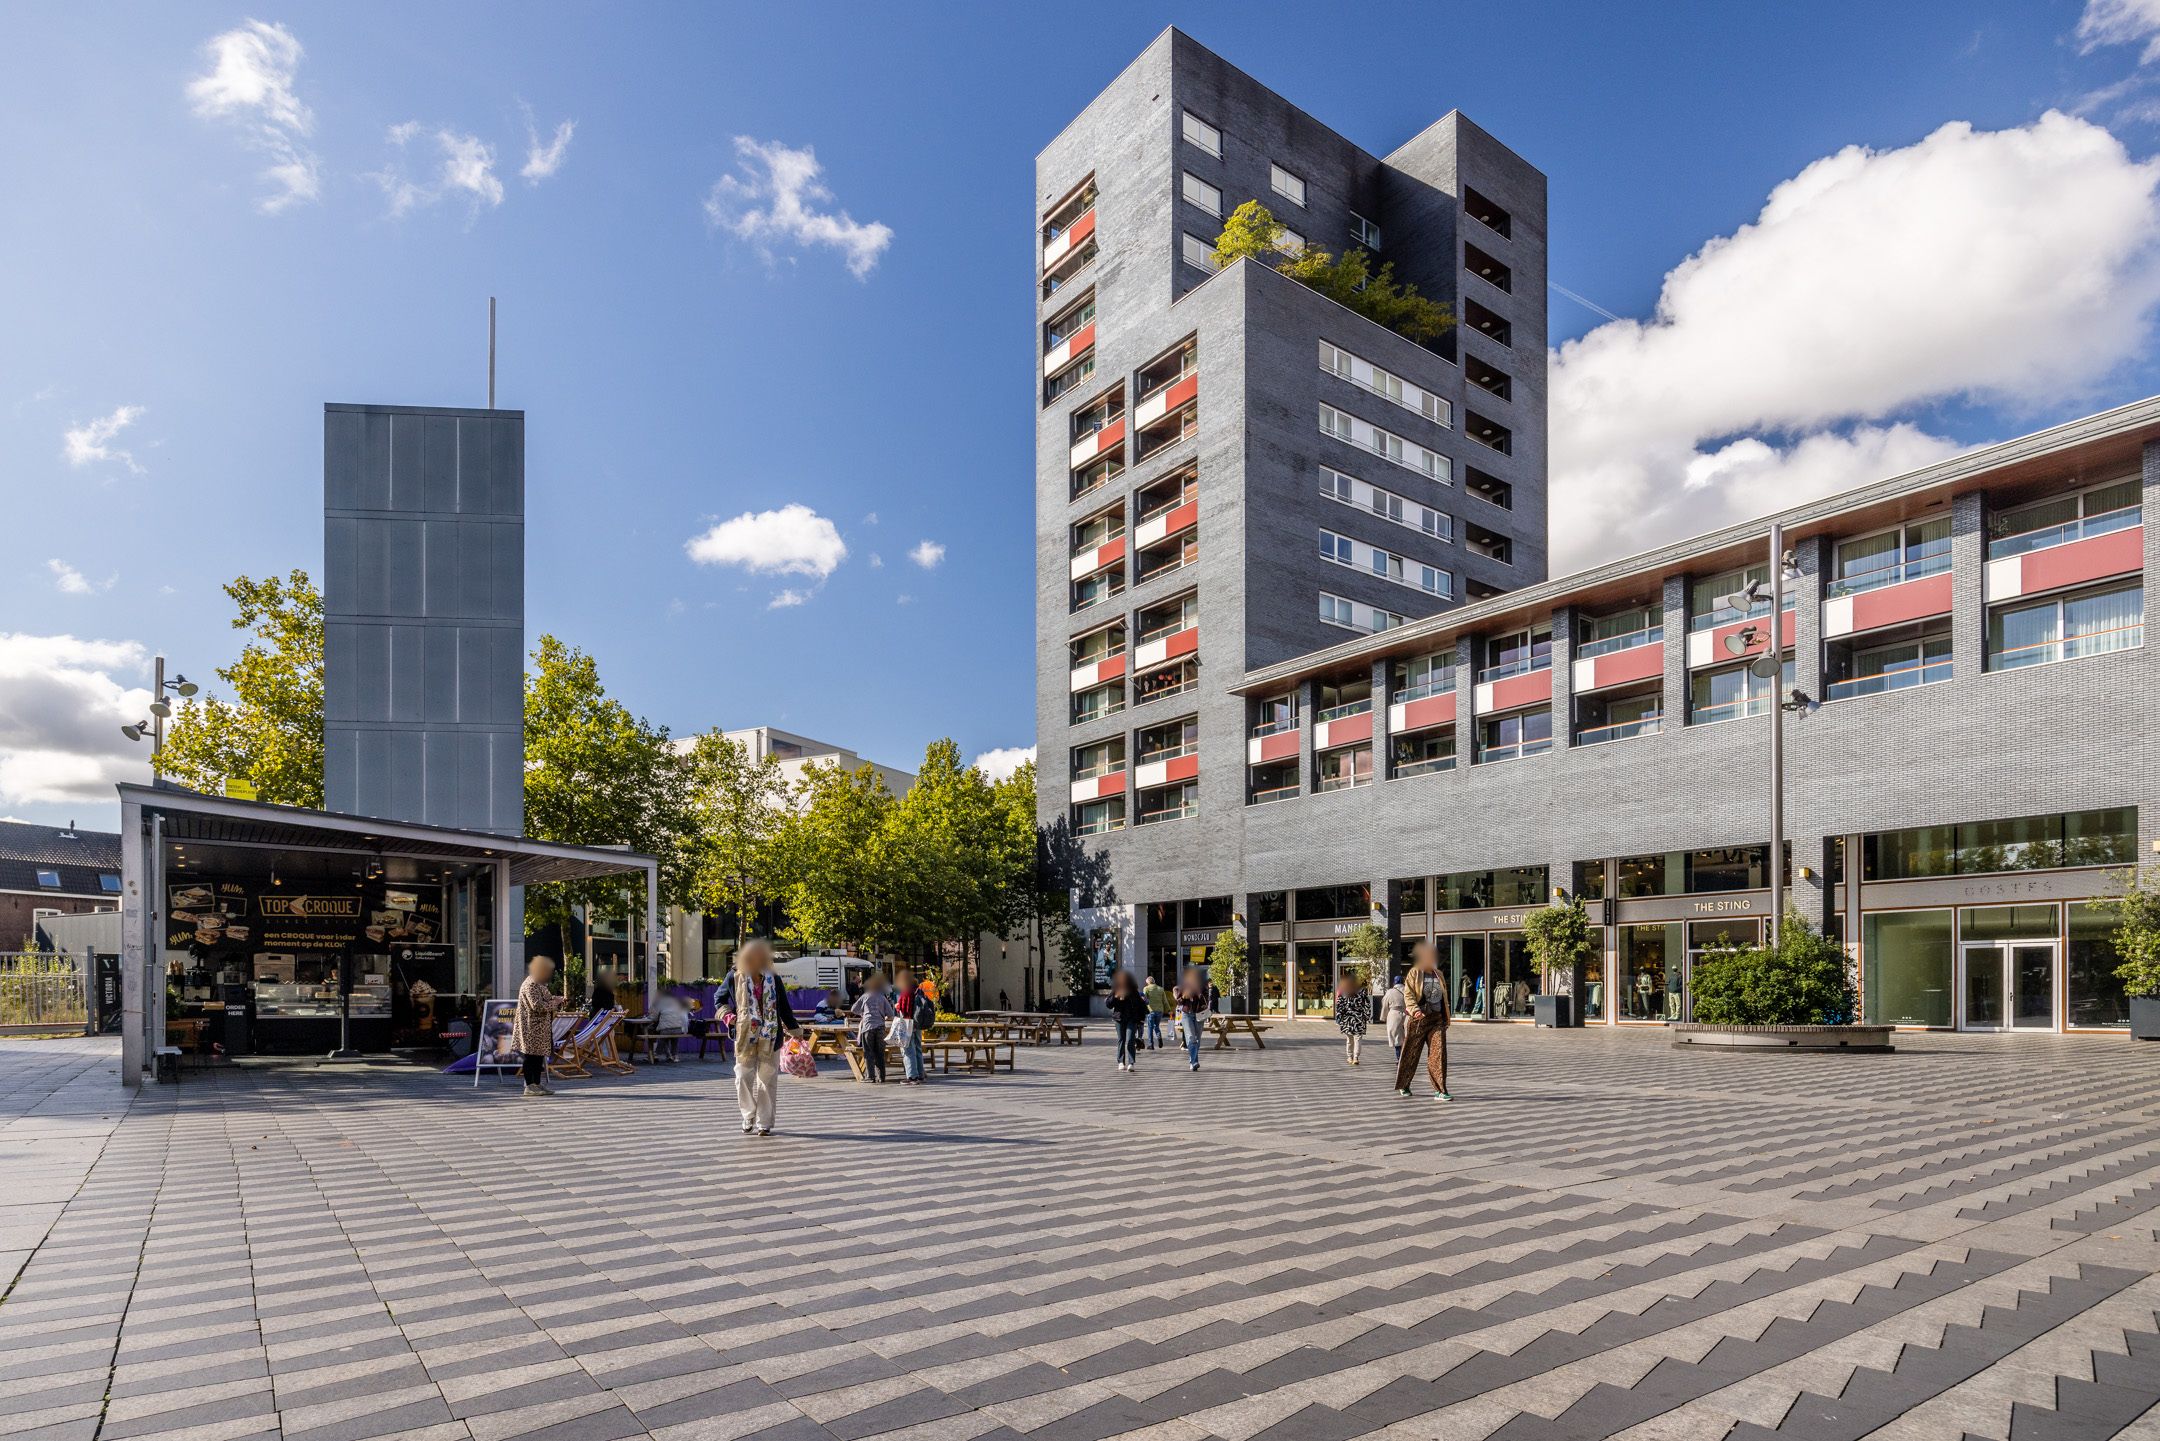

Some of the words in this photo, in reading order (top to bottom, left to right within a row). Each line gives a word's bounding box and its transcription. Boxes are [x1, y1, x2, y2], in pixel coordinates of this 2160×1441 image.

[265, 900, 289, 913] TOP
[305, 900, 353, 914] CROQUE
[1694, 902, 1714, 912] THE
[1717, 900, 1751, 911] STING
[1493, 915, 1509, 924] THE
[1636, 924, 1650, 932] THE
[1652, 923, 1666, 931] STI
[104, 976, 113, 1005] VICTORIA
